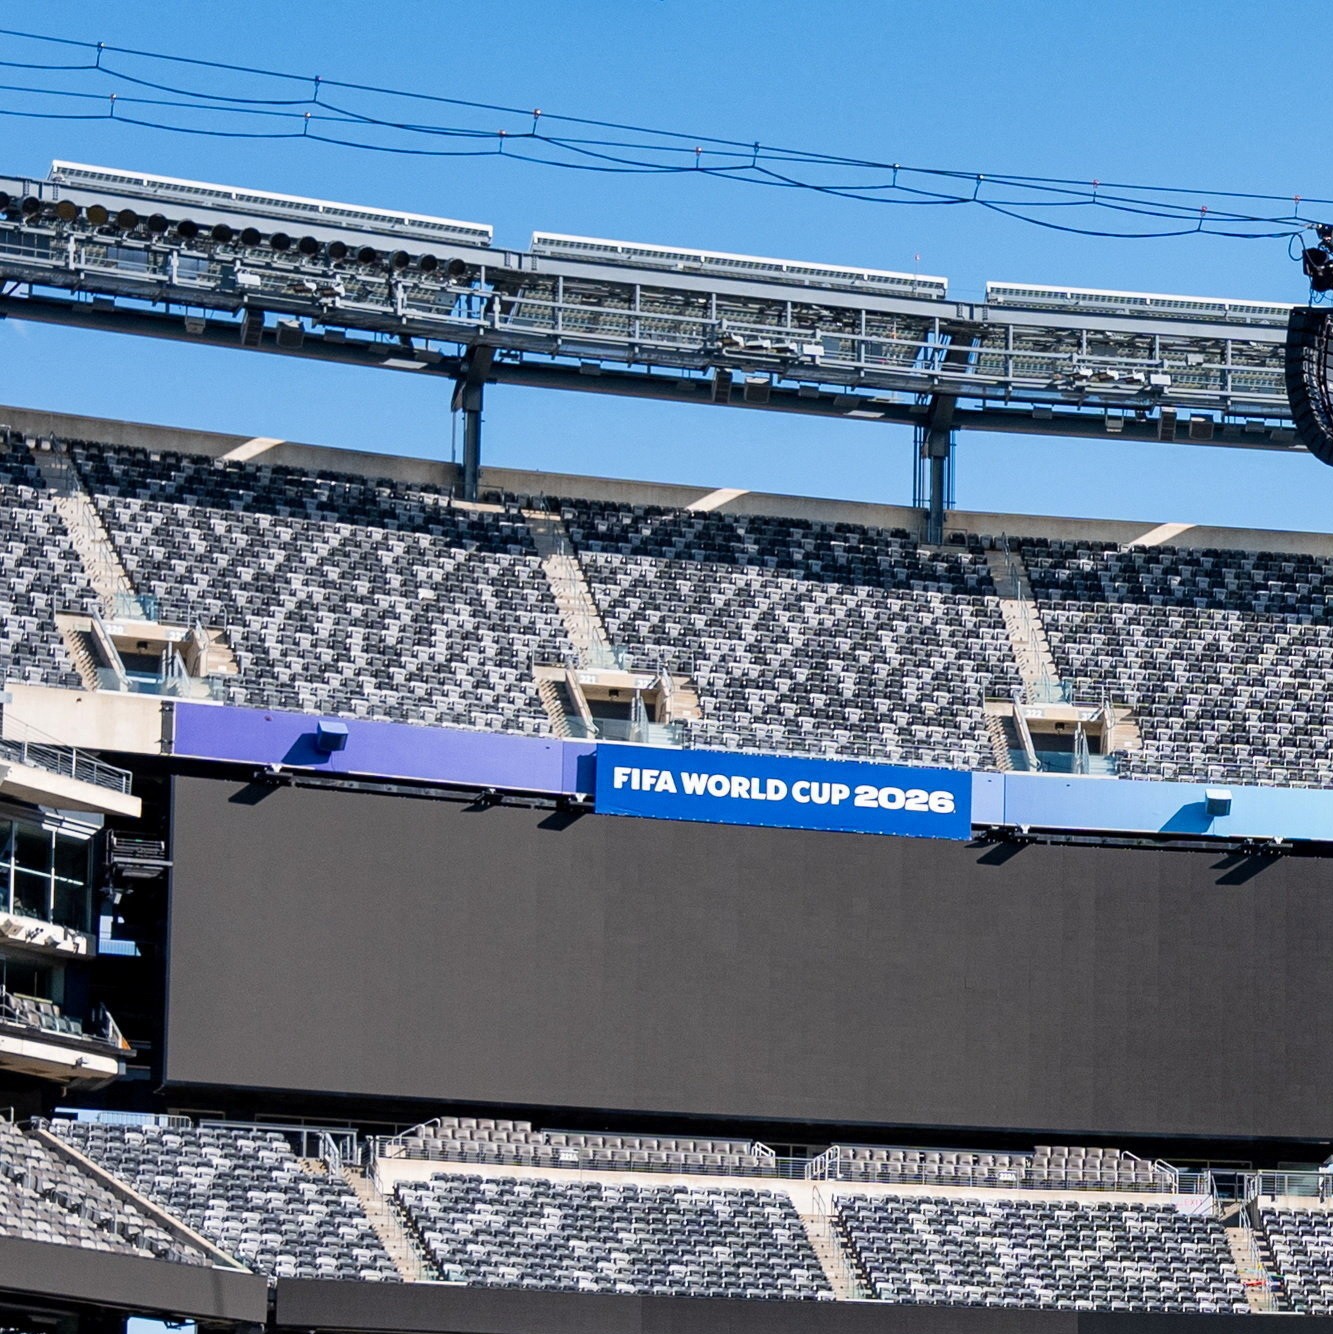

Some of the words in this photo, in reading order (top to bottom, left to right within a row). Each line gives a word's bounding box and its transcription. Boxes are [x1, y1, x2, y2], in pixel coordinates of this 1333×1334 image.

[613, 767, 676, 793] FIFA
[680, 771, 787, 801] WORLD
[791, 780, 851, 807] CUP
[854, 786, 953, 814] 2026
